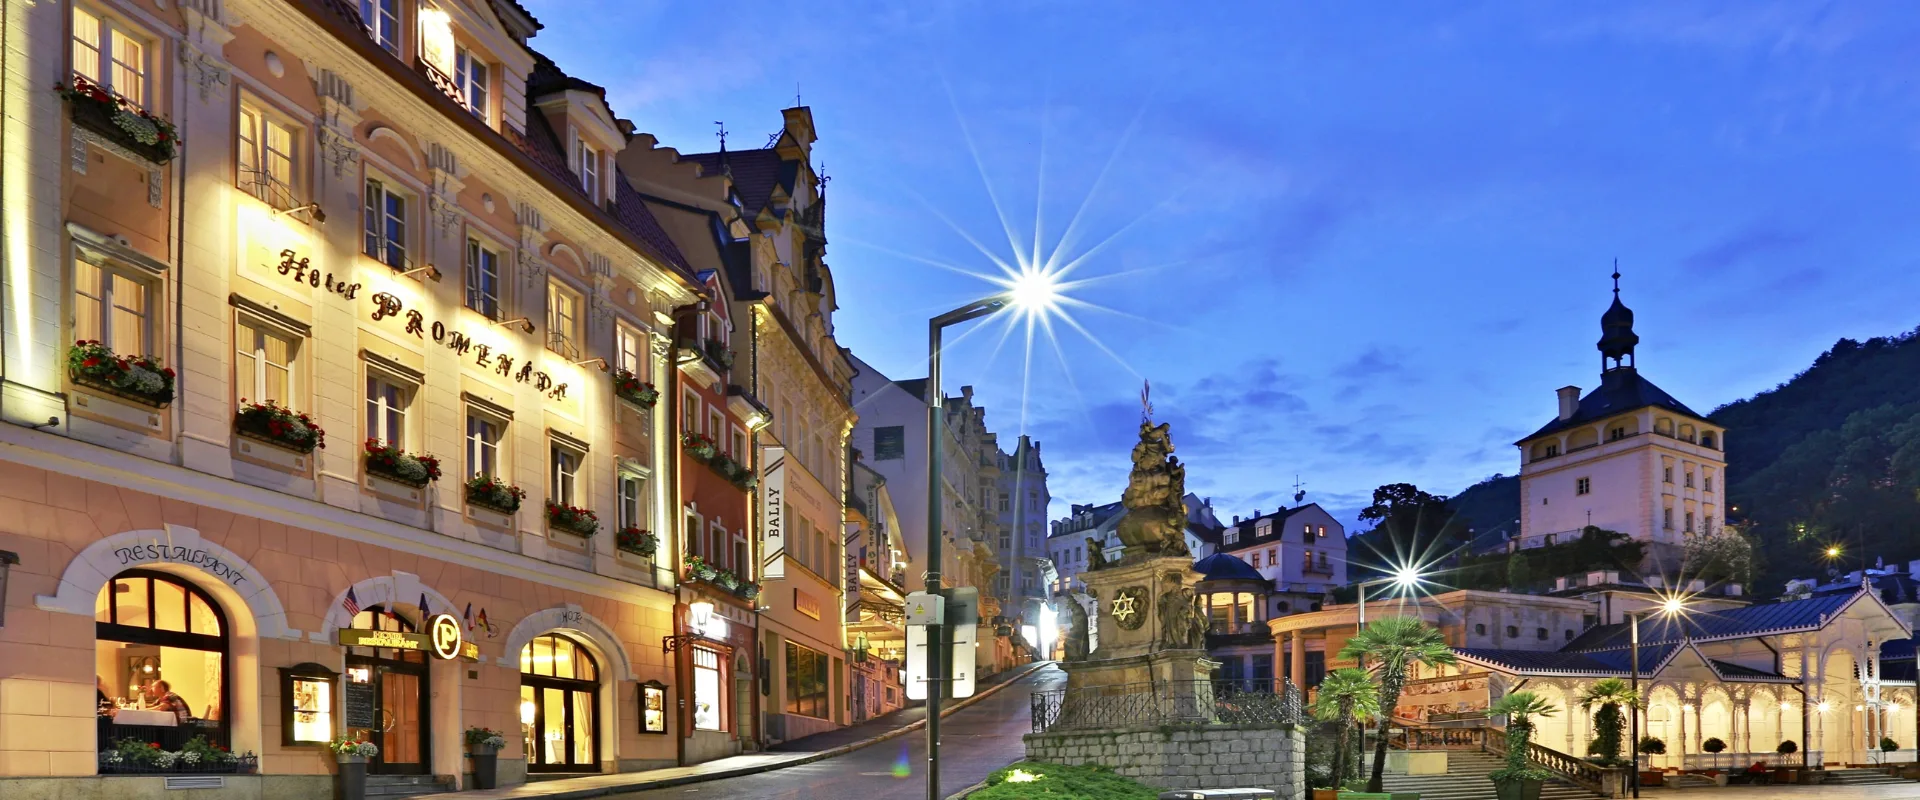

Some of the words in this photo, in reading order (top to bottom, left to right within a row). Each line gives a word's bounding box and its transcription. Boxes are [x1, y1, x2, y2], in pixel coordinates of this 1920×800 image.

[277, 248, 362, 301] Hotel
[371, 291, 569, 402] PROMENÁDA
[769, 487, 780, 538] BALLY
[848, 553, 857, 593] BALLY
